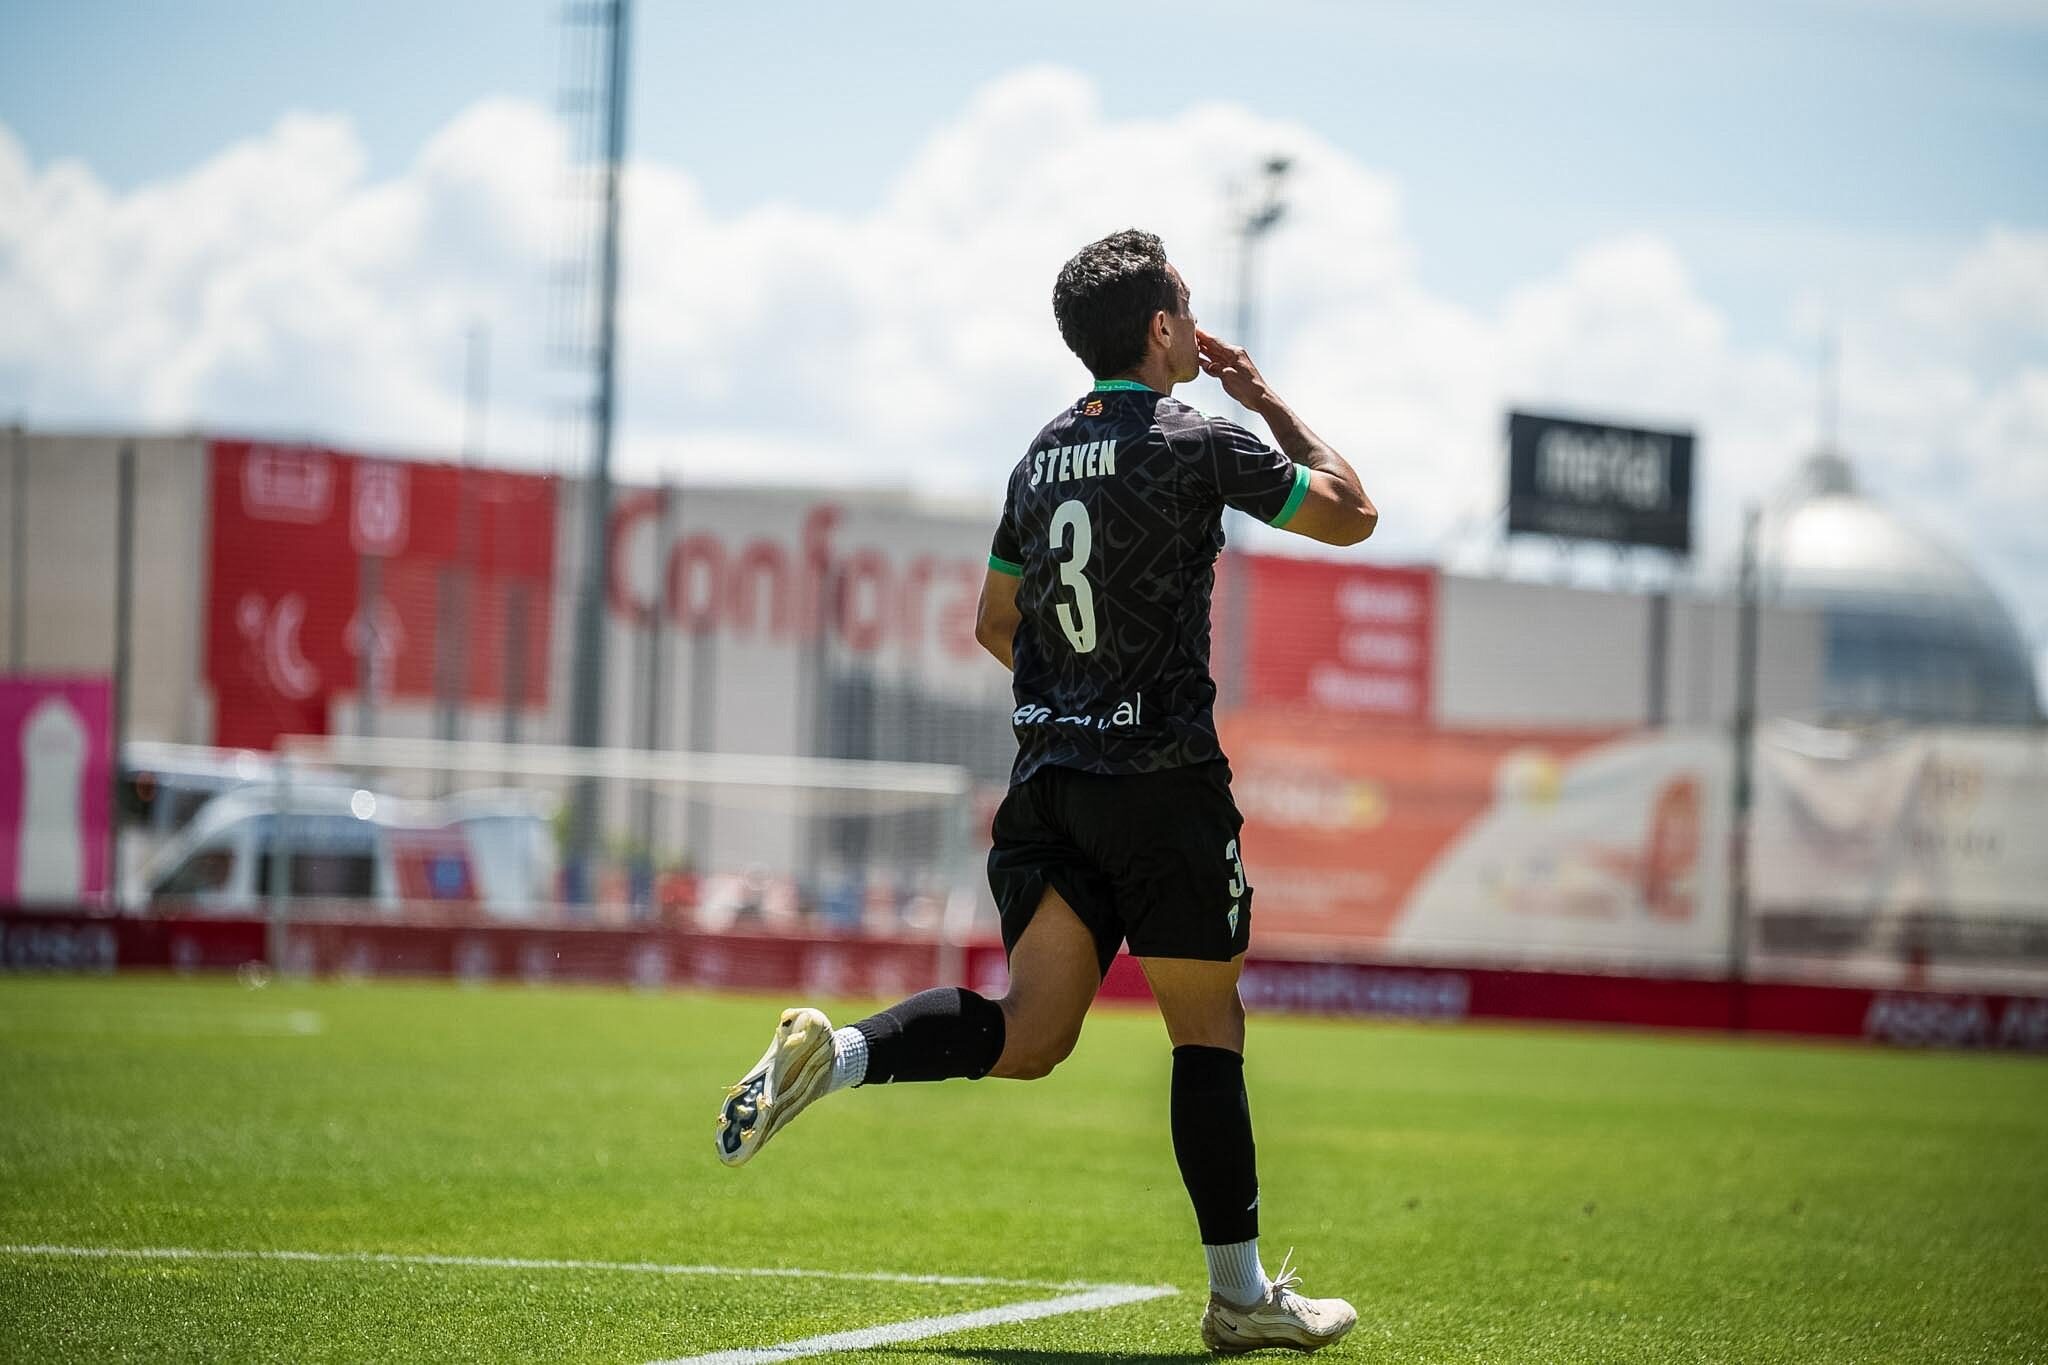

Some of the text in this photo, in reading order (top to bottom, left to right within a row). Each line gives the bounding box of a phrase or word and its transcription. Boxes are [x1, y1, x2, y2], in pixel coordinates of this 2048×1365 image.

[1031, 439, 1117, 485] STEVEN
[1050, 499, 1097, 653] 3
[1226, 839, 1245, 898] 3
